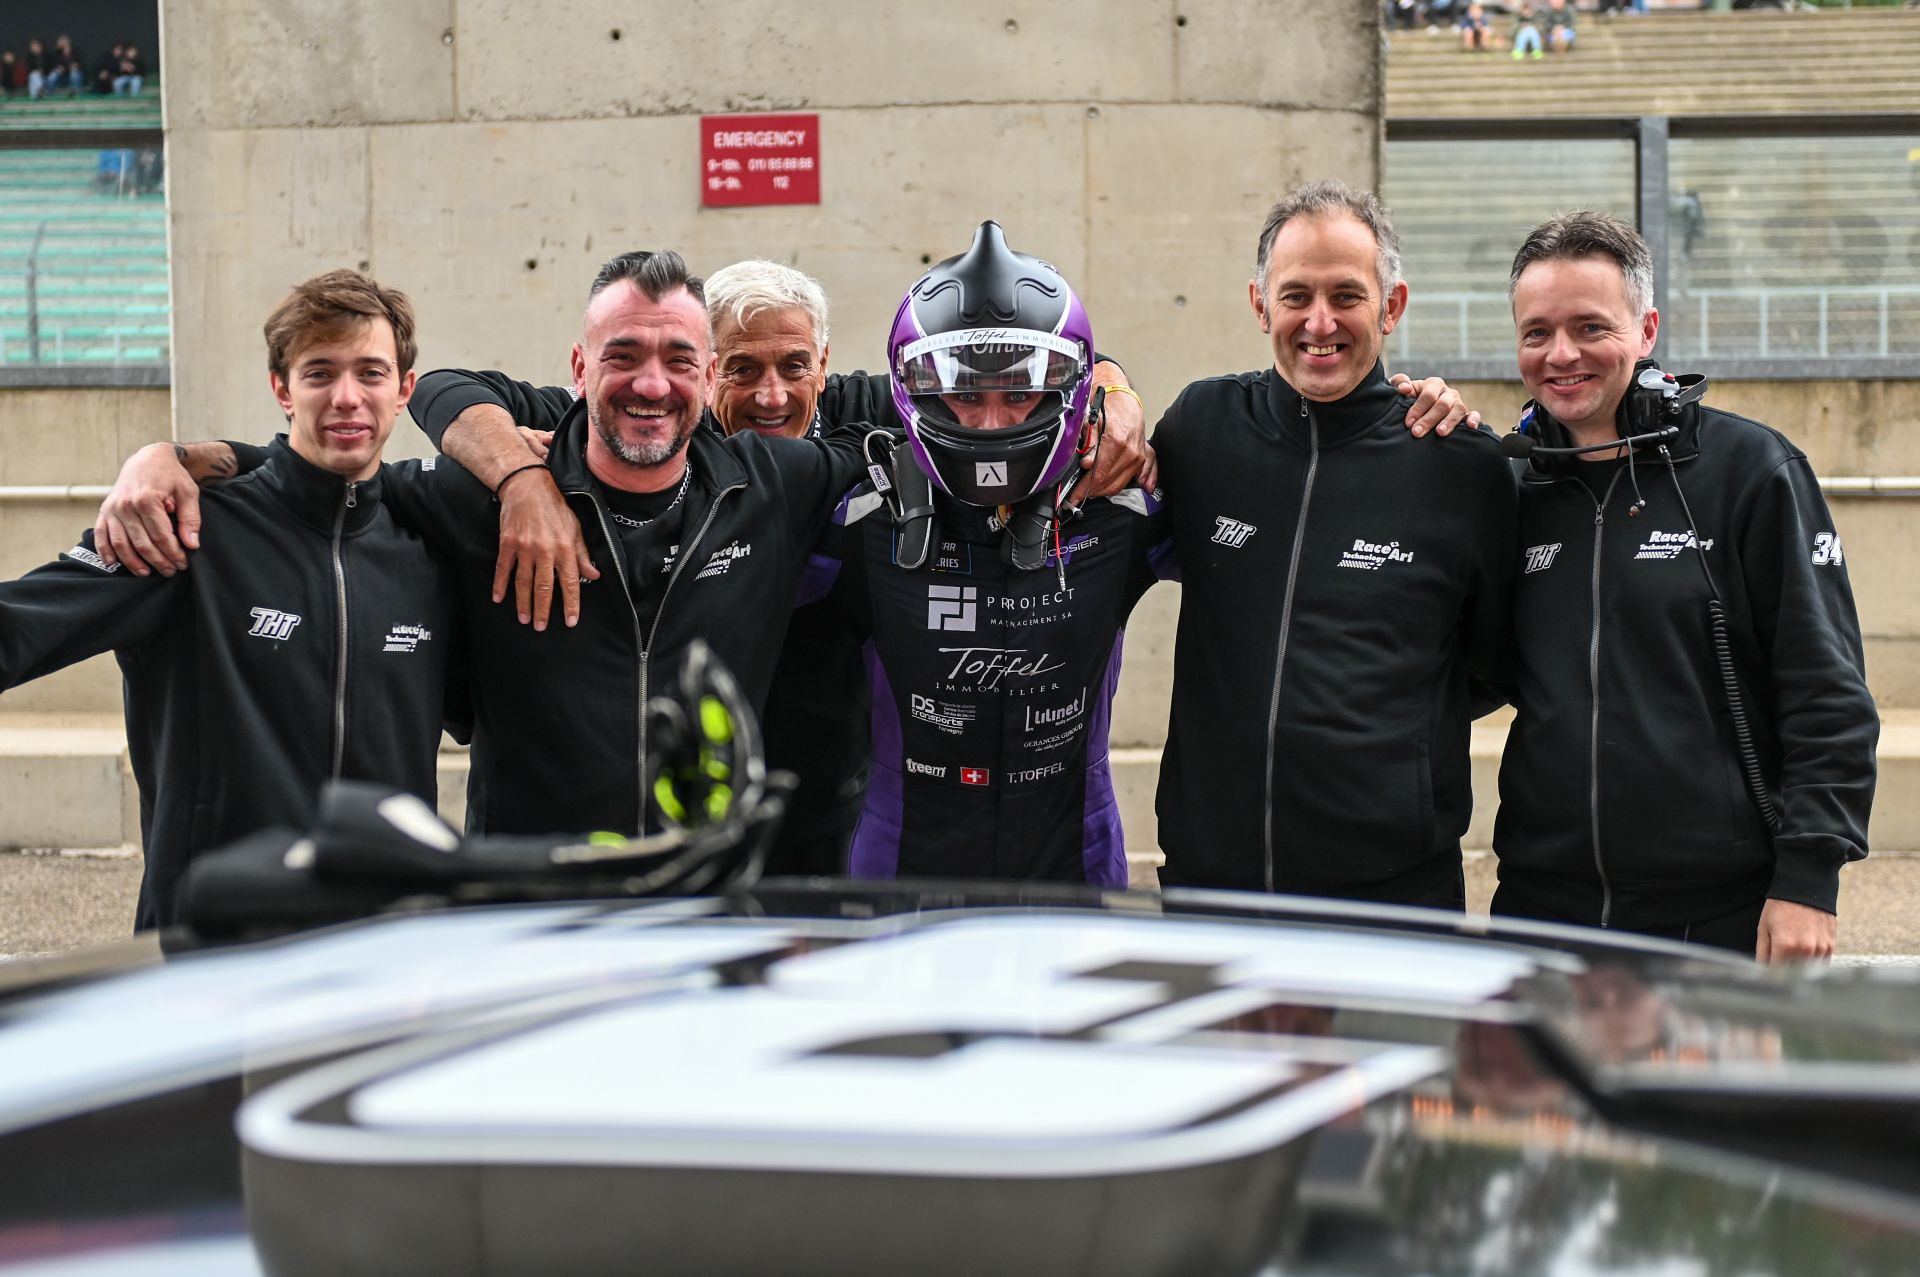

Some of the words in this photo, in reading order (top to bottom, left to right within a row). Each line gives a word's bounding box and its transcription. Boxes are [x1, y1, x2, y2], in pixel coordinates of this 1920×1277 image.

[713, 130, 806, 149] EMERGENCY
[1211, 515, 1257, 549] THT
[1047, 536, 1099, 557] OOSIER
[1639, 543, 1684, 552] Technology
[1811, 531, 1843, 566] 34
[1342, 551, 1387, 564] Technology
[1524, 542, 1562, 574] THT
[247, 606, 302, 641] THT
[936, 682, 1060, 696] IMMOBILIER
[911, 693, 935, 714] DS
[911, 707, 964, 727] transports
[905, 757, 947, 778] freem
